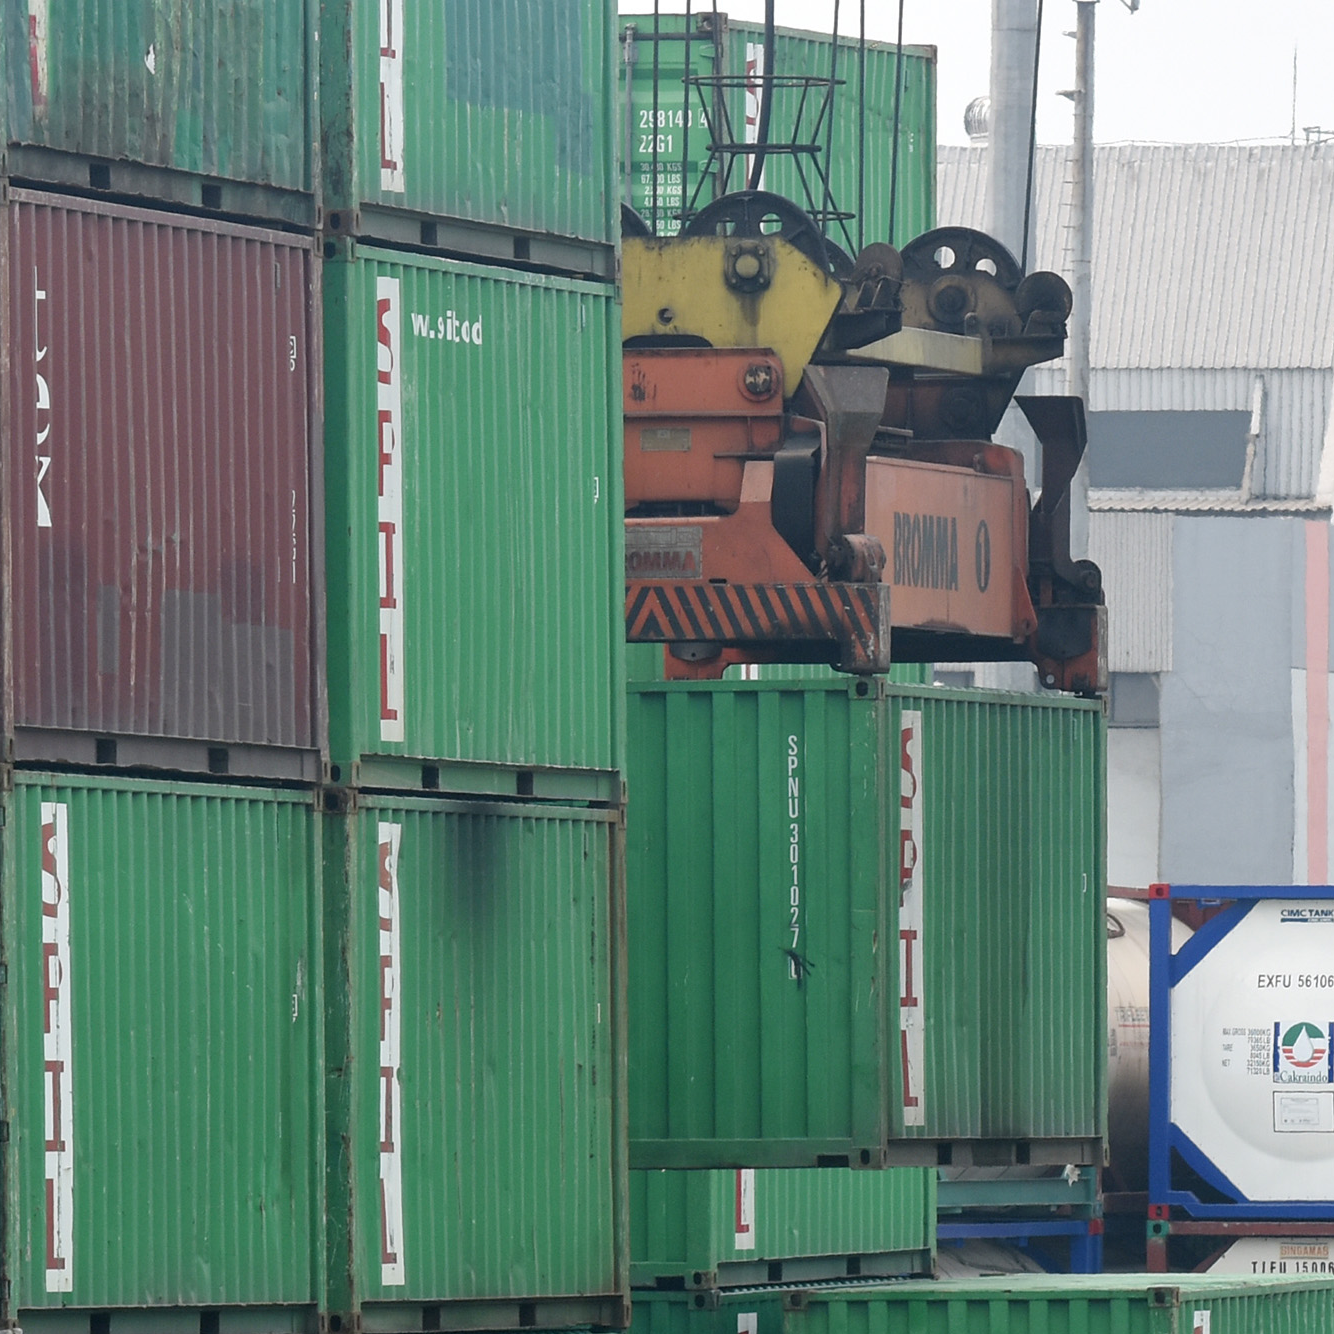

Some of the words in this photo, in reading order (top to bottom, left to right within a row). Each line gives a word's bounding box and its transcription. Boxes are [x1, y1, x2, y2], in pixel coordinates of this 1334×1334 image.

[894, 512, 958, 591] BROMMA
[787, 735, 798, 819] SPNU
[1280, 909, 1307, 917] CIMC
[1308, 909, 1334, 917] TANK
[1258, 974, 1292, 988] EXFU
[1280, 1070, 1328, 1082] Cakraindo
